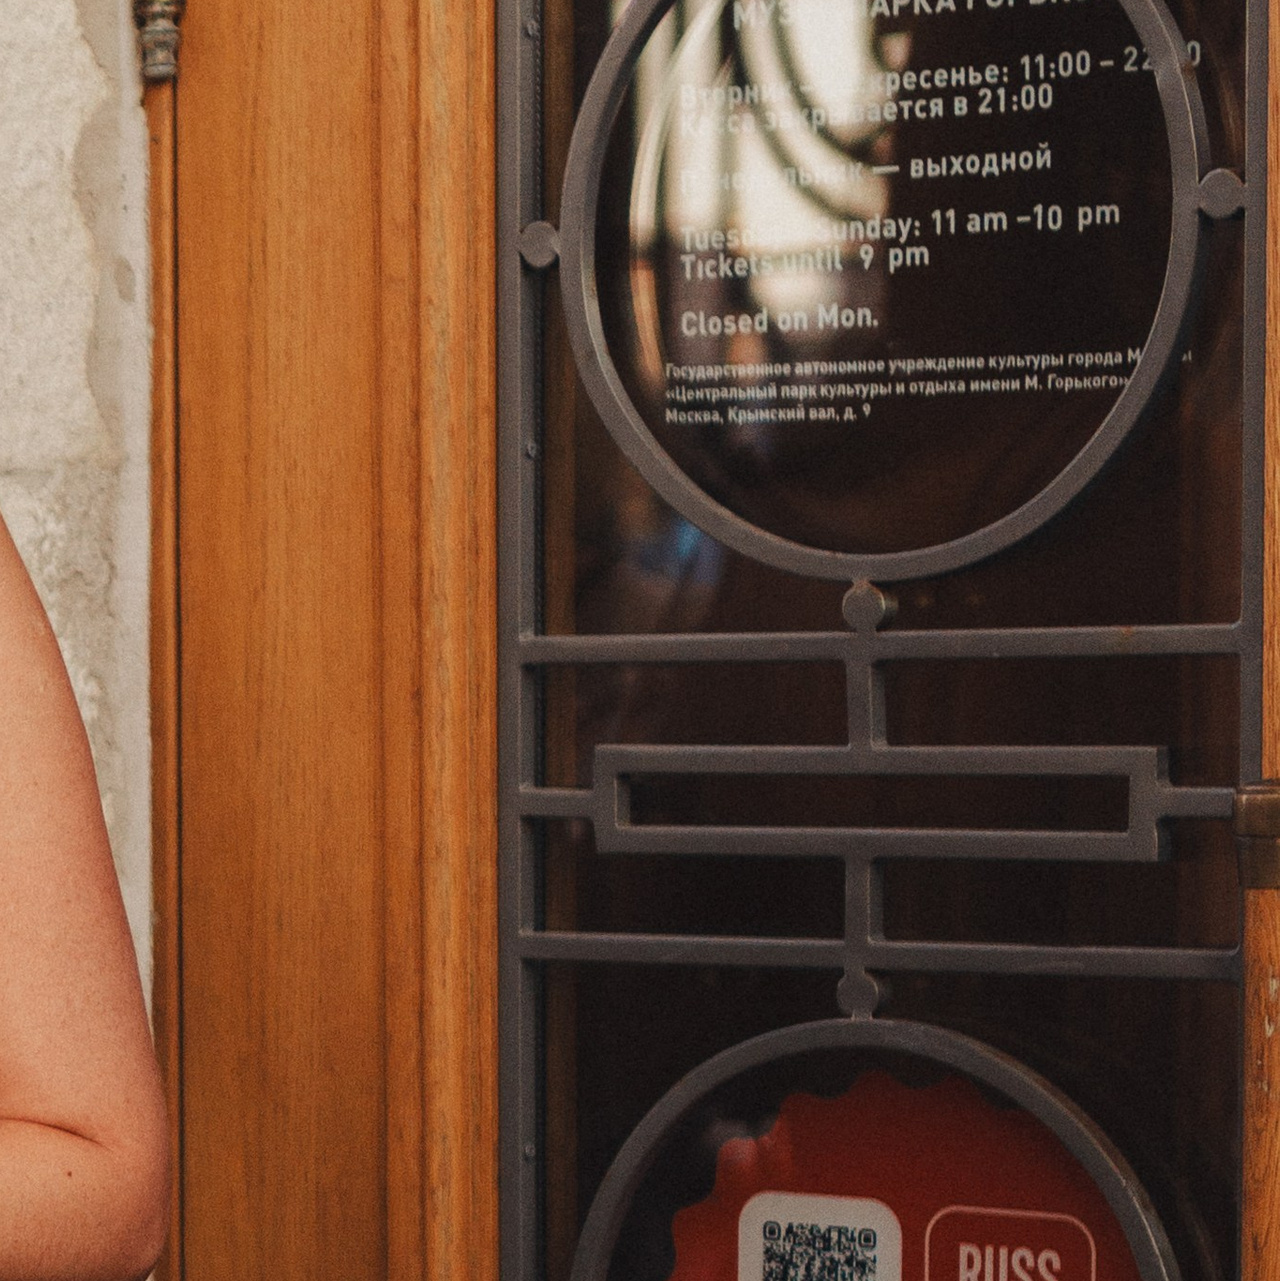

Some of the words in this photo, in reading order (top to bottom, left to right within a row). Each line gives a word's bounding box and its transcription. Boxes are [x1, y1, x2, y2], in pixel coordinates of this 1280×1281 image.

[1021, 51, 1092, 81] 11:00
[1124, 41, 1201, 72] 220
[954, 97, 968, 117] в
[978, 83, 1053, 115] 21:00
[910, 142, 1052, 179] выходной
[931, 208, 956, 236] 11
[966, 211, 1008, 233] am
[1078, 204, 1120, 233] pm
[681, 251, 773, 281] Tickets
[782, 244, 843, 273] until
[860, 242, 874, 271] 9
[888, 245, 929, 274] pm
[681, 307, 768, 336] Closed
[777, 314, 808, 334] on
[817, 303, 879, 331] Mon.
[665, 361, 791, 382] Государственное
[794, 358, 885, 377] автономное
[888, 356, 985, 376] учреждение
[989, 351, 1064, 370] культуры
[1068, 348, 1123, 367] города
[780, 383, 818, 401] парк
[820, 380, 892, 400] культуры
[895, 381, 905, 394] и
[909, 377, 966, 397] отдыха
[970, 376, 1021, 393] имени
[1024, 375, 1043, 391] М.
[665, 406, 724, 424] Москва,
[727, 403, 805, 425] Крымский
[808, 405, 840, 422] вал,
